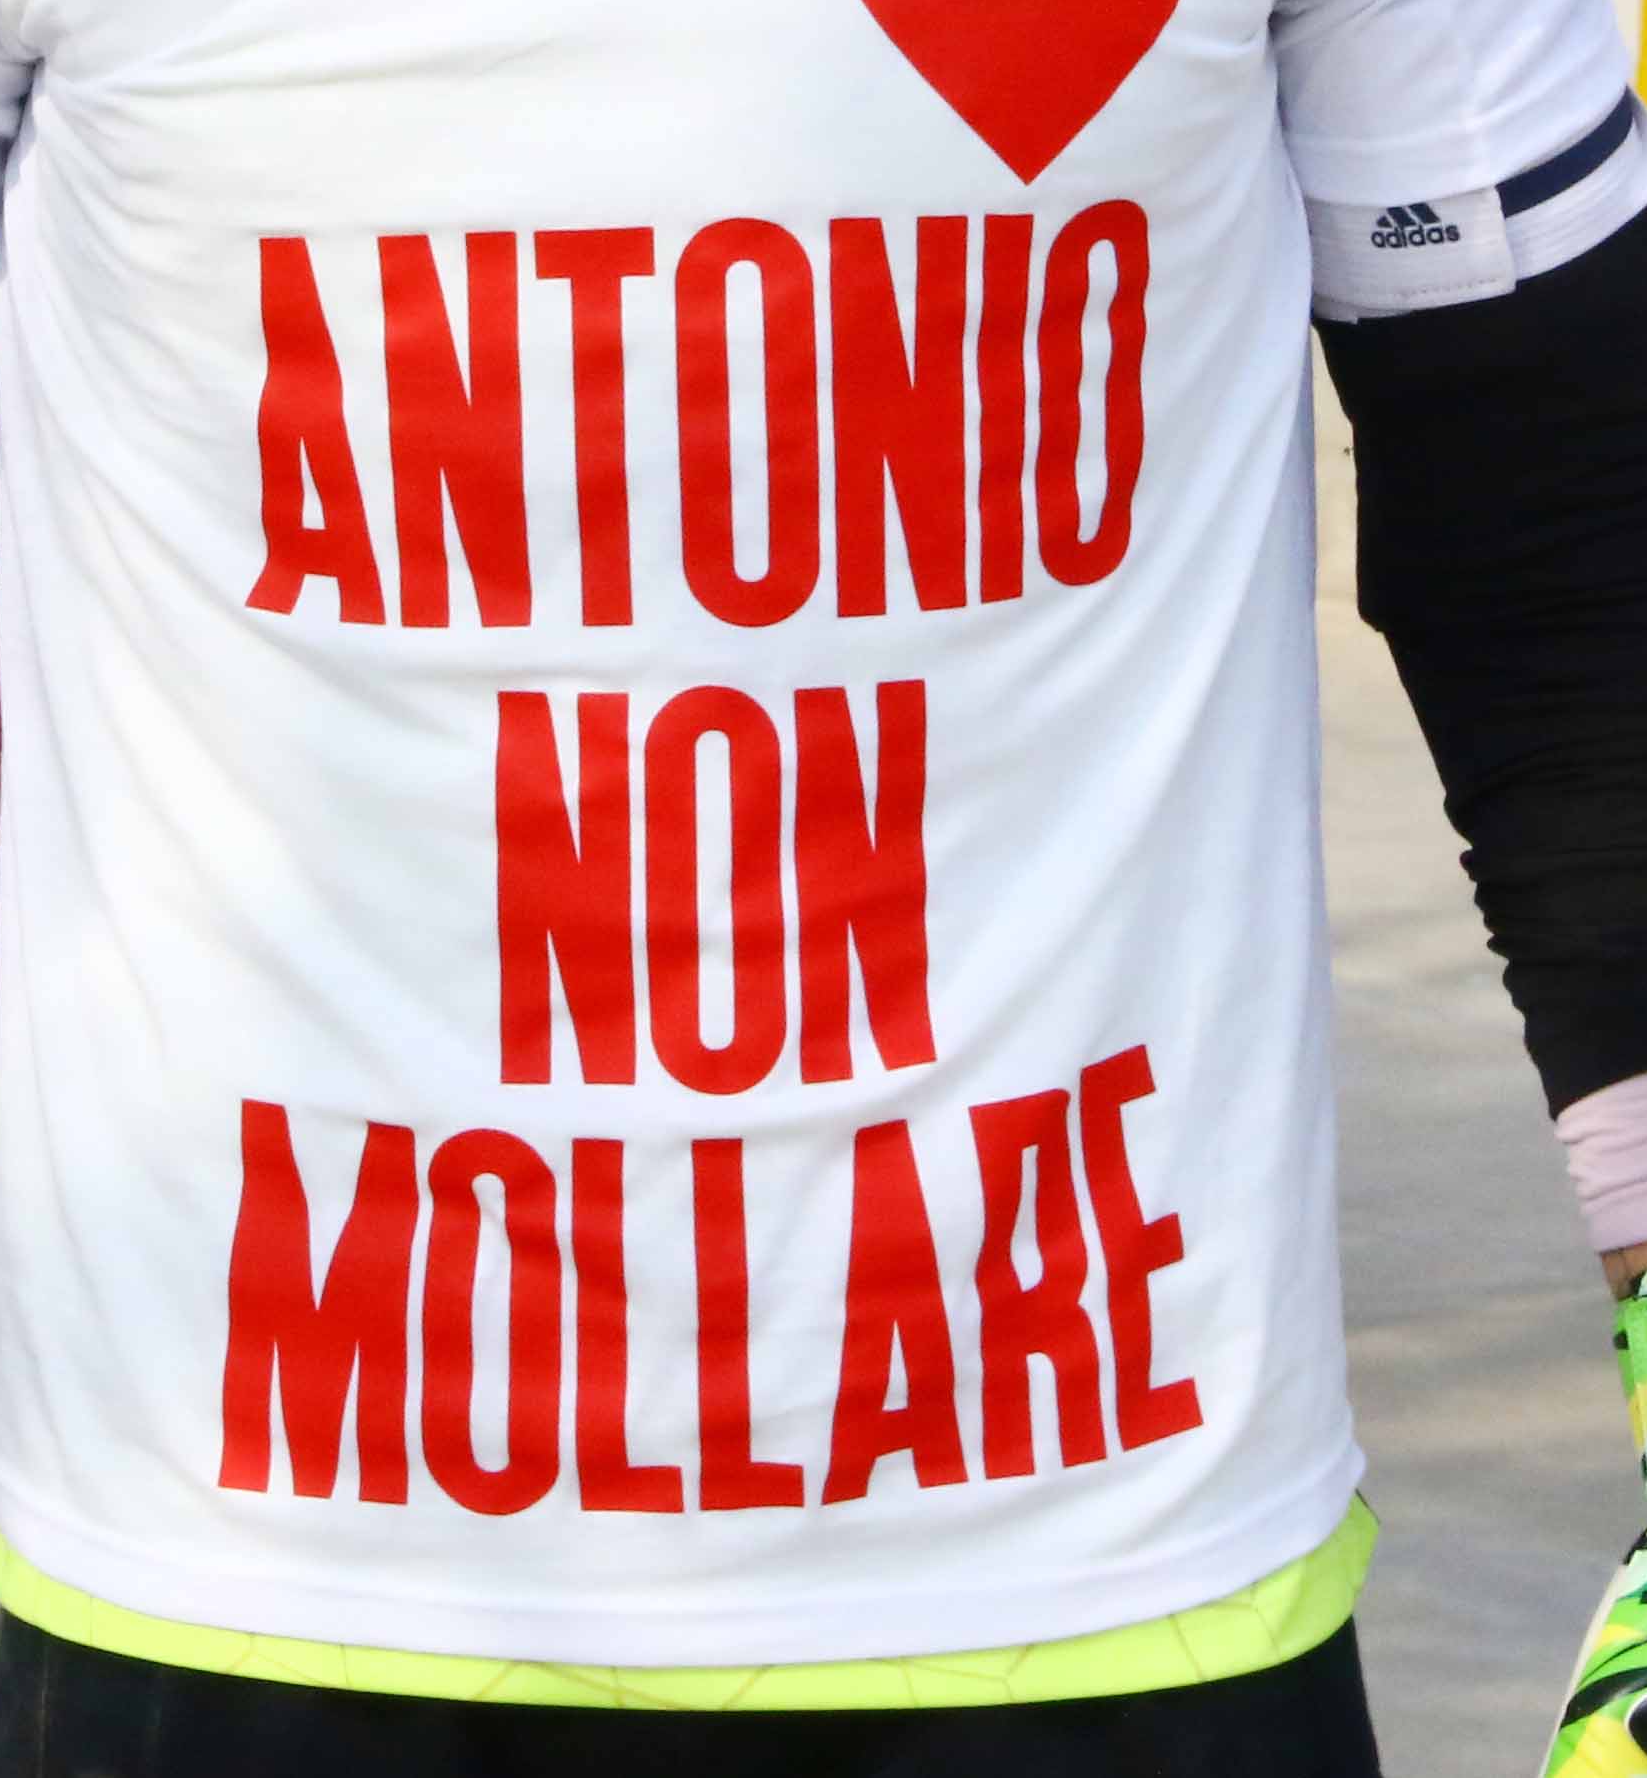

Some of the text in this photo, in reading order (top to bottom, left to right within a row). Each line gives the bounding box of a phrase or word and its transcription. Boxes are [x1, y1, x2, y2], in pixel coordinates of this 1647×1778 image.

[246, 198, 1151, 630] ANTONIO
[1370, 223, 1461, 250] adidas
[494, 678, 938, 1097] NON
[218, 1044, 1204, 1517] MOLLARE
